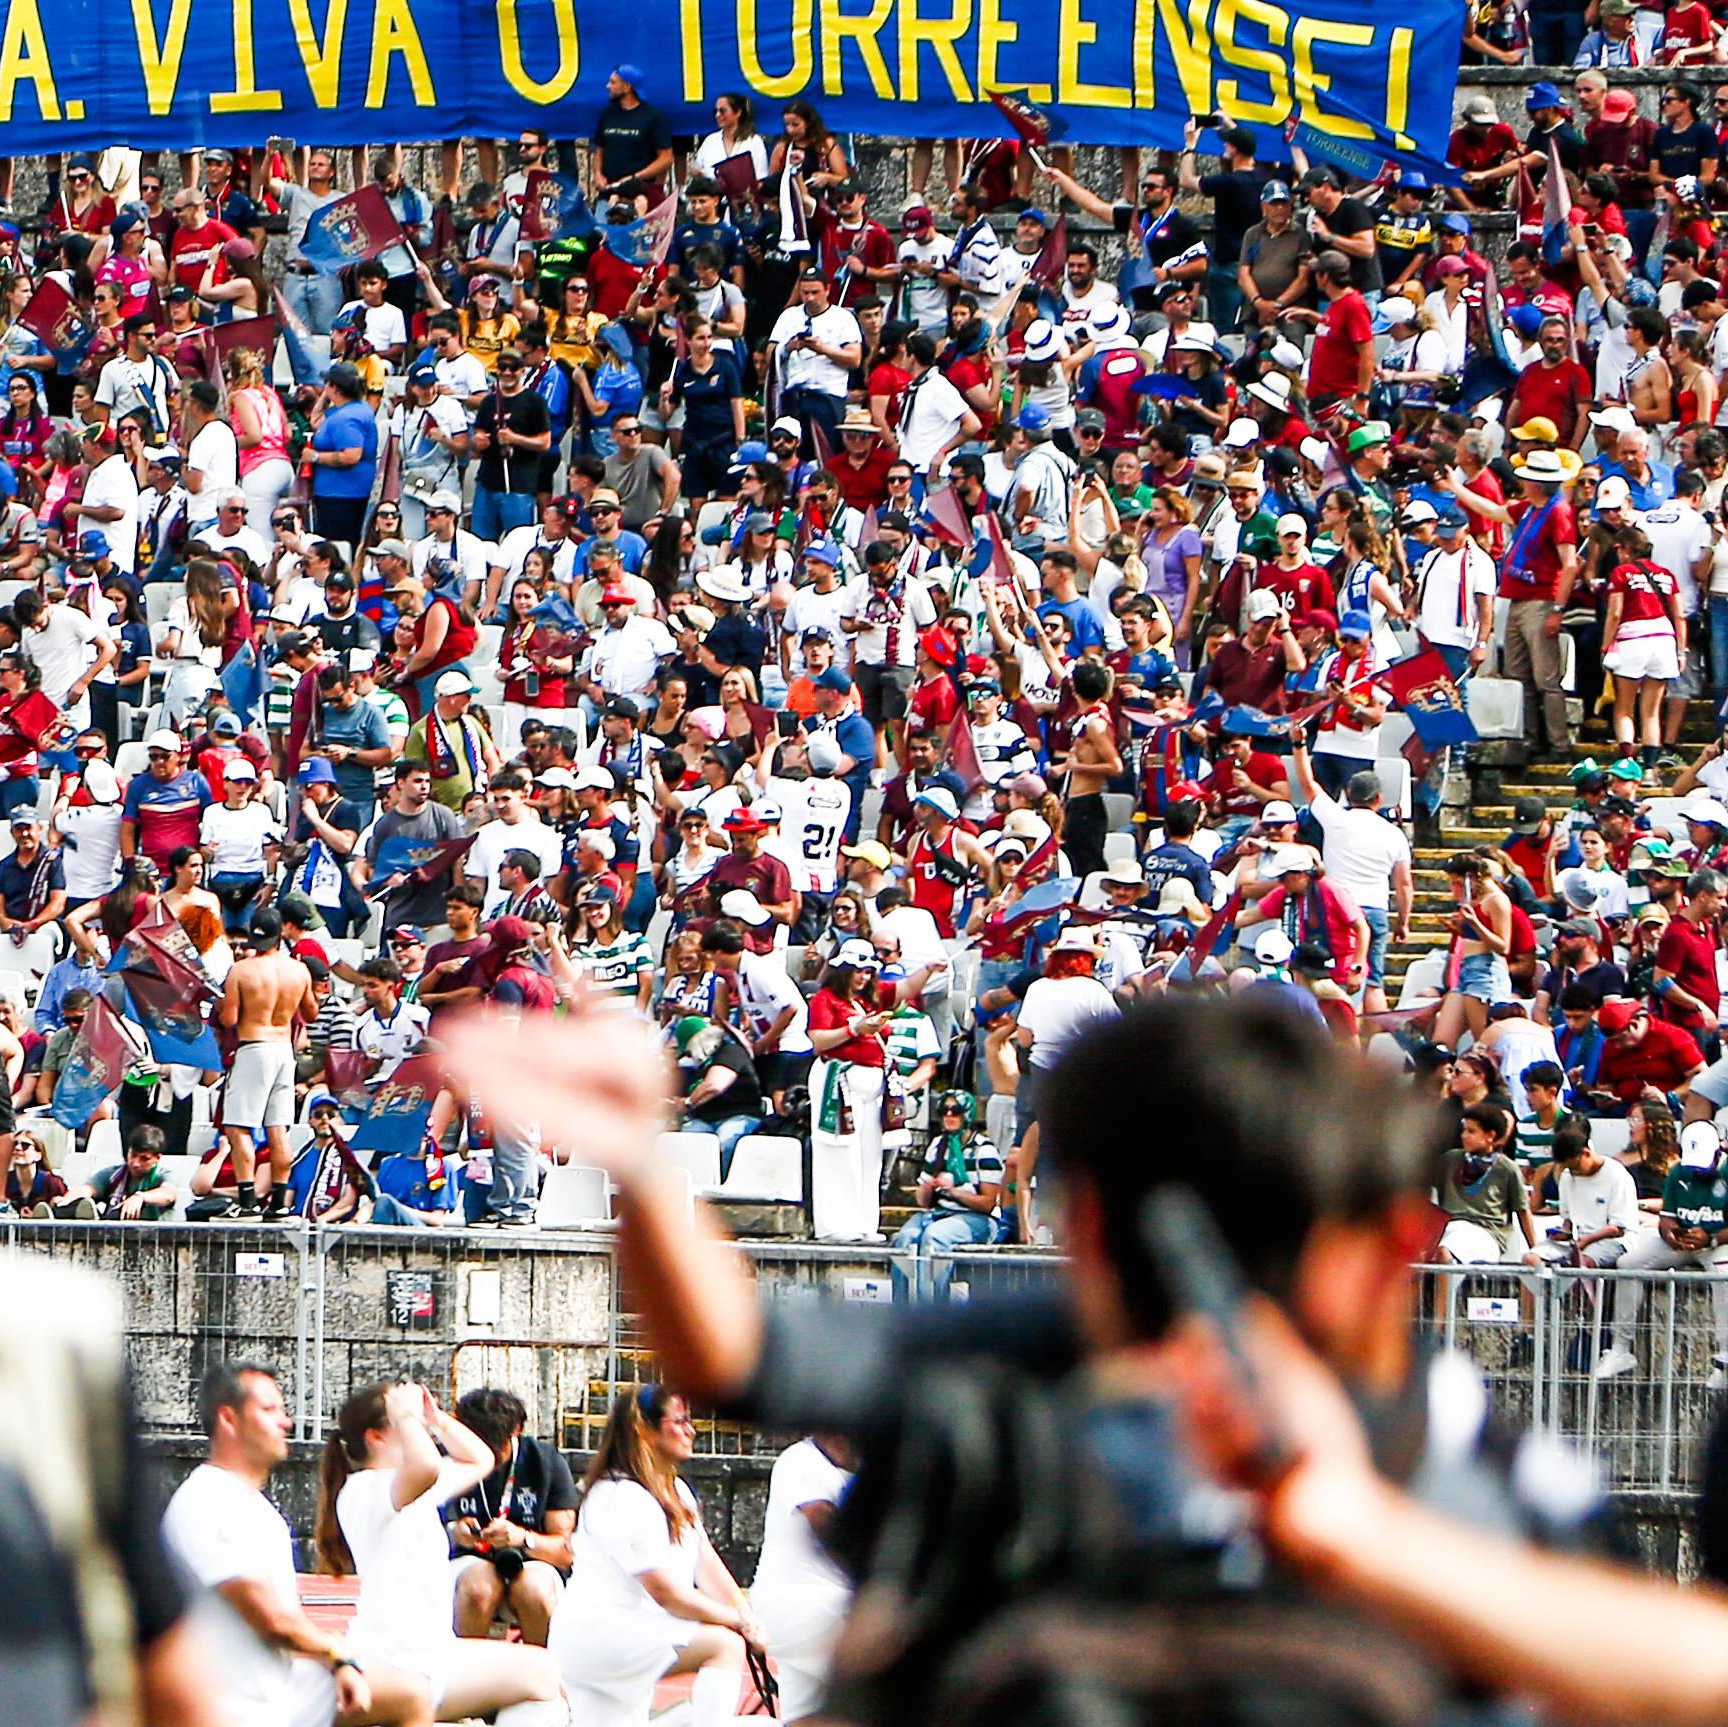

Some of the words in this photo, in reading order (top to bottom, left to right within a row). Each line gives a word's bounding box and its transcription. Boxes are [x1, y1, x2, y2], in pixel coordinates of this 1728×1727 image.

[1305, 128, 1370, 170] TORREENSE
[1280, 591, 1296, 610] 16
[803, 823, 836, 860] 21
[594, 963, 627, 981] MEO
[391, 1308, 409, 1324] 12
